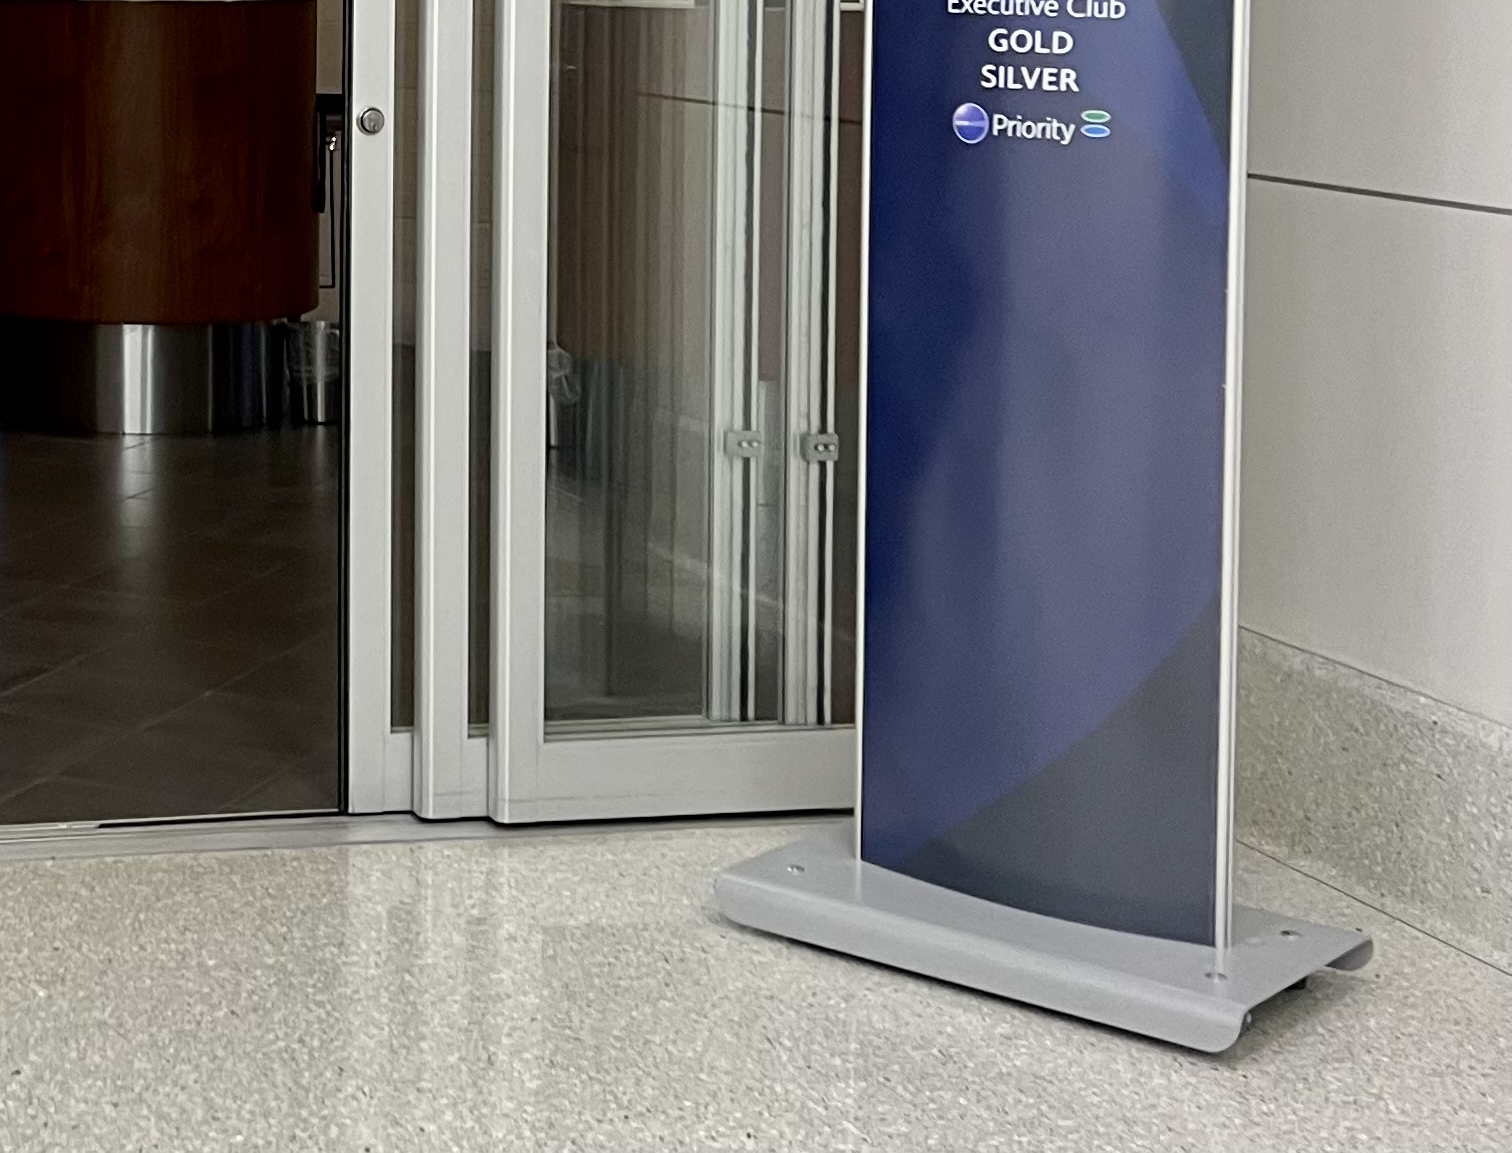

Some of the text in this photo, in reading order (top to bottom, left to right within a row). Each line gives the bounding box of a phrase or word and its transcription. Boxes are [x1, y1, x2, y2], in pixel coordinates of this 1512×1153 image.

[988, 28, 1074, 54] GOLD
[980, 64, 1080, 92] SILVER
[992, 113, 1076, 145] Priority
